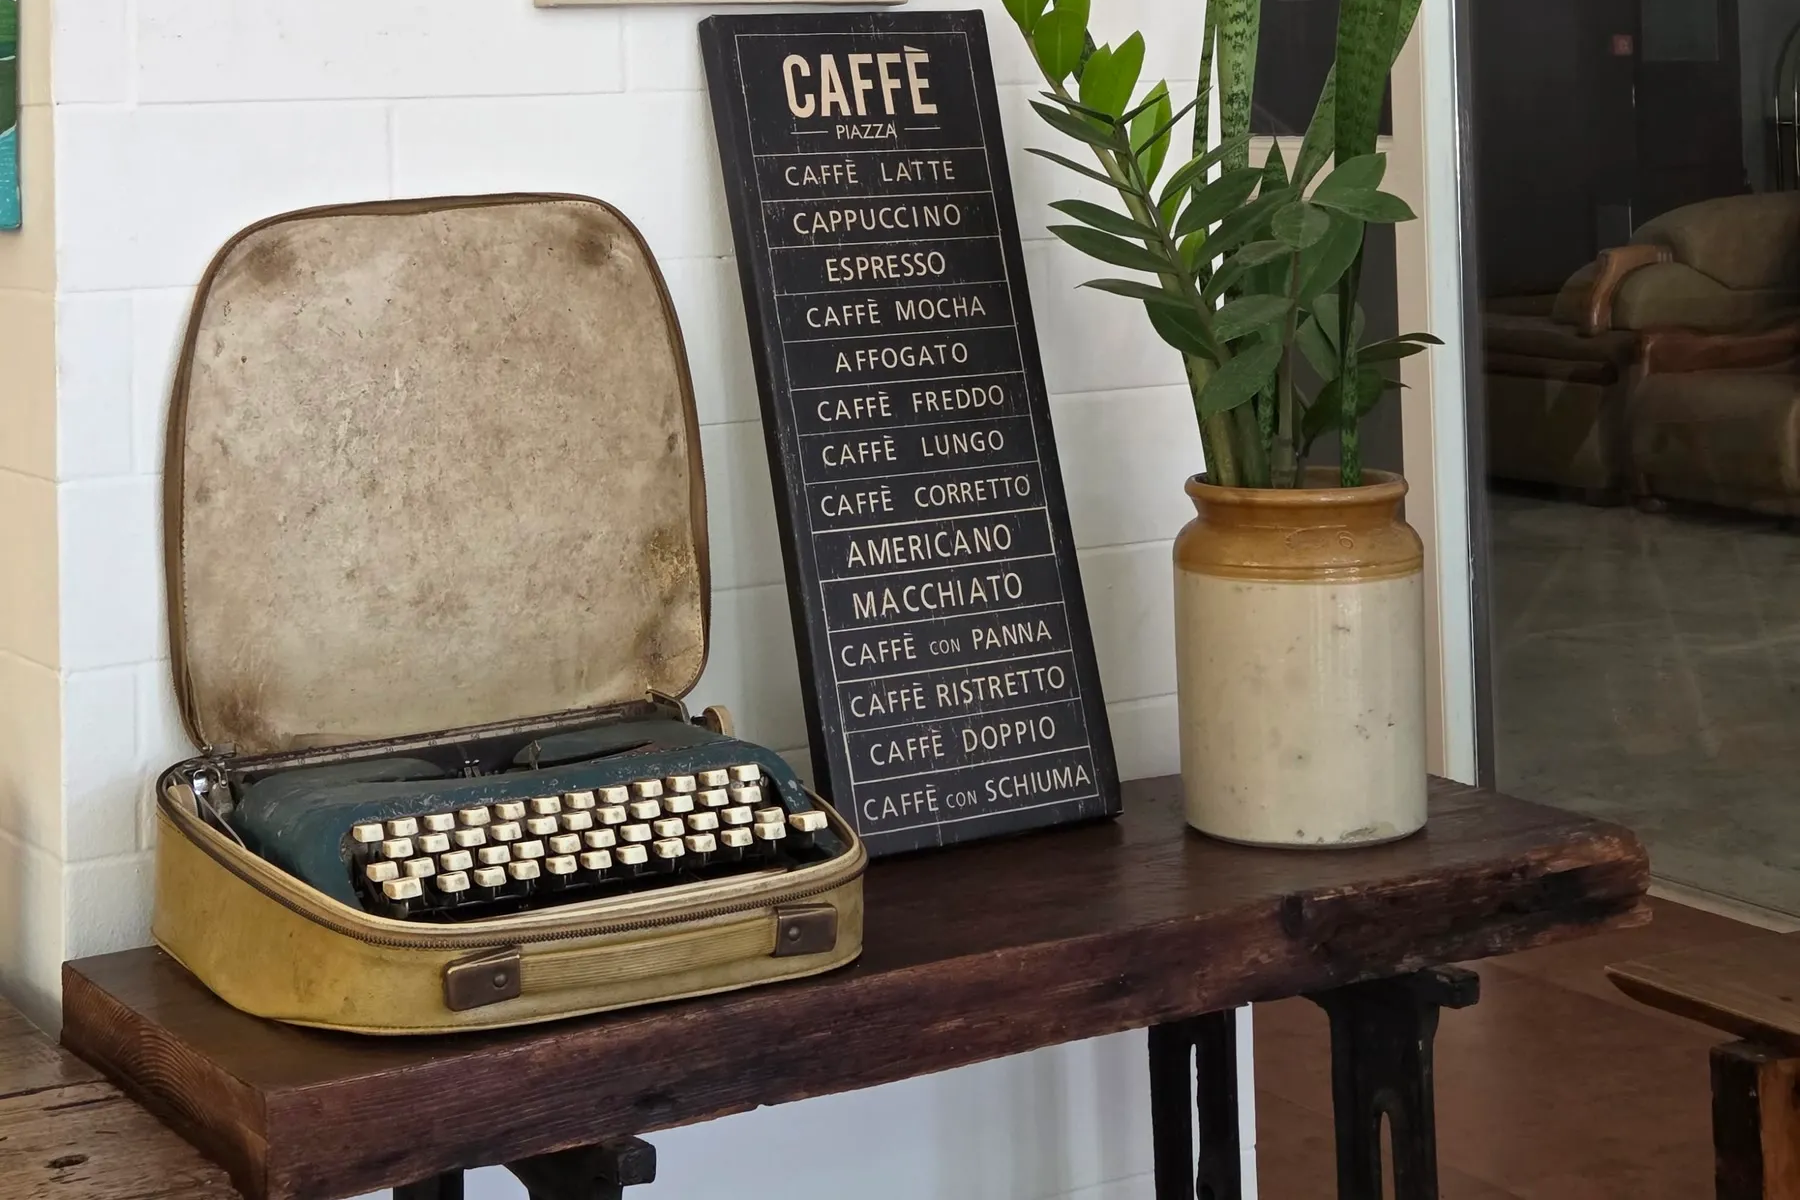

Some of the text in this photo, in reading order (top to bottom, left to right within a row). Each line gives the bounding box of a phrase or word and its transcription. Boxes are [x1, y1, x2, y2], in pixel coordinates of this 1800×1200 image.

[782, 45, 938, 118] CAFFÈ
[835, 123, 898, 139] PIAZZA
[785, 159, 956, 186] CAFFÈ LATTE
[793, 204, 961, 234] CAPPUCCINO
[826, 252, 946, 282] ESPRESSO
[806, 296, 986, 328] CAFFÈ MOCHA
[835, 342, 968, 373] AFFOGATO
[817, 385, 1004, 422] CAFFÈ FREDDO
[822, 430, 1004, 467] CAFFÈ LUNGO
[820, 475, 1030, 517] CAFFÈ CORRETTO
[847, 524, 1012, 568] AMERICANO
[852, 572, 1023, 619] MACCHIATO
[841, 620, 1052, 667] CAFFÈ CON PANNA
[850, 665, 1065, 718] CAFFÈ RISTRETTO
[870, 716, 1056, 766] CAFFÈ DOPPIO
[863, 765, 1091, 821] CAFFÈ CON SCHIUMA
